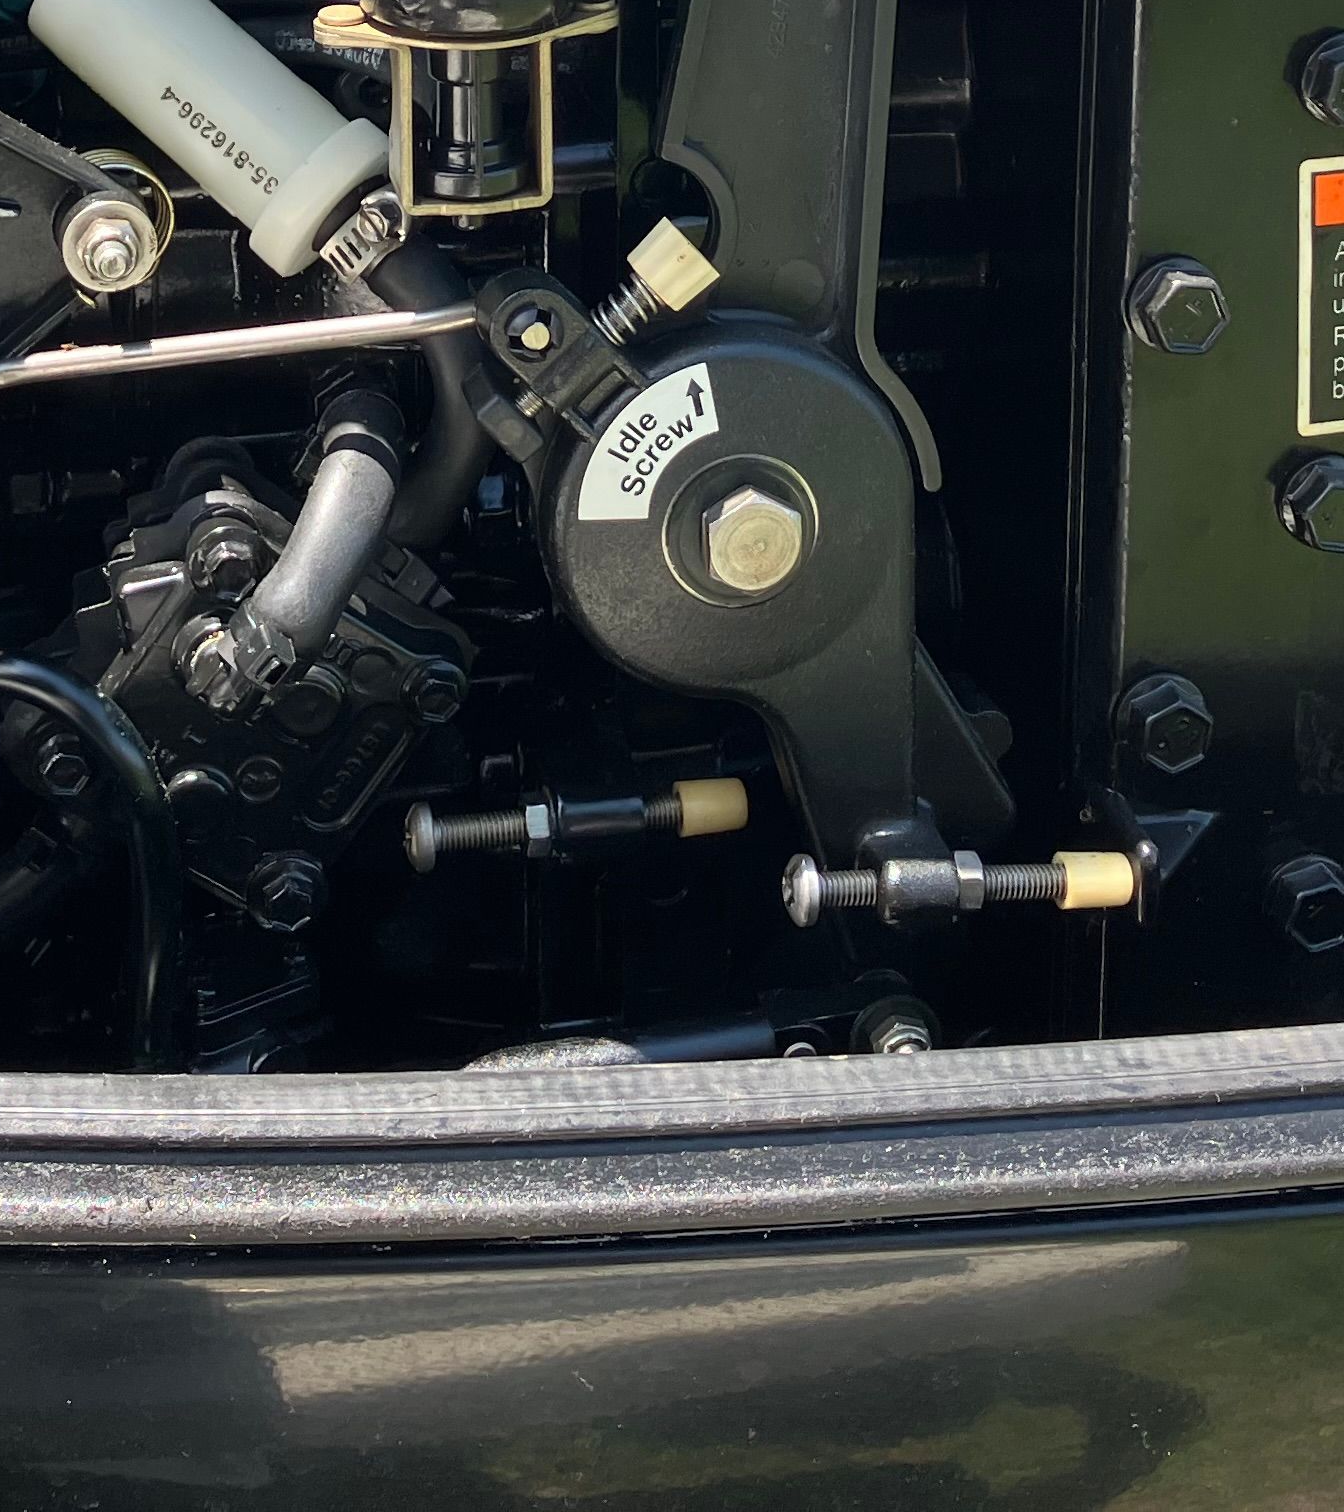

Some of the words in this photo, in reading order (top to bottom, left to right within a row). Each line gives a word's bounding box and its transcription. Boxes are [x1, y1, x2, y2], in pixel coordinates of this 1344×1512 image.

[160, 85, 279, 195] 35-816296-4
[608, 412, 657, 463] Idle
[621, 414, 693, 496] Screw
